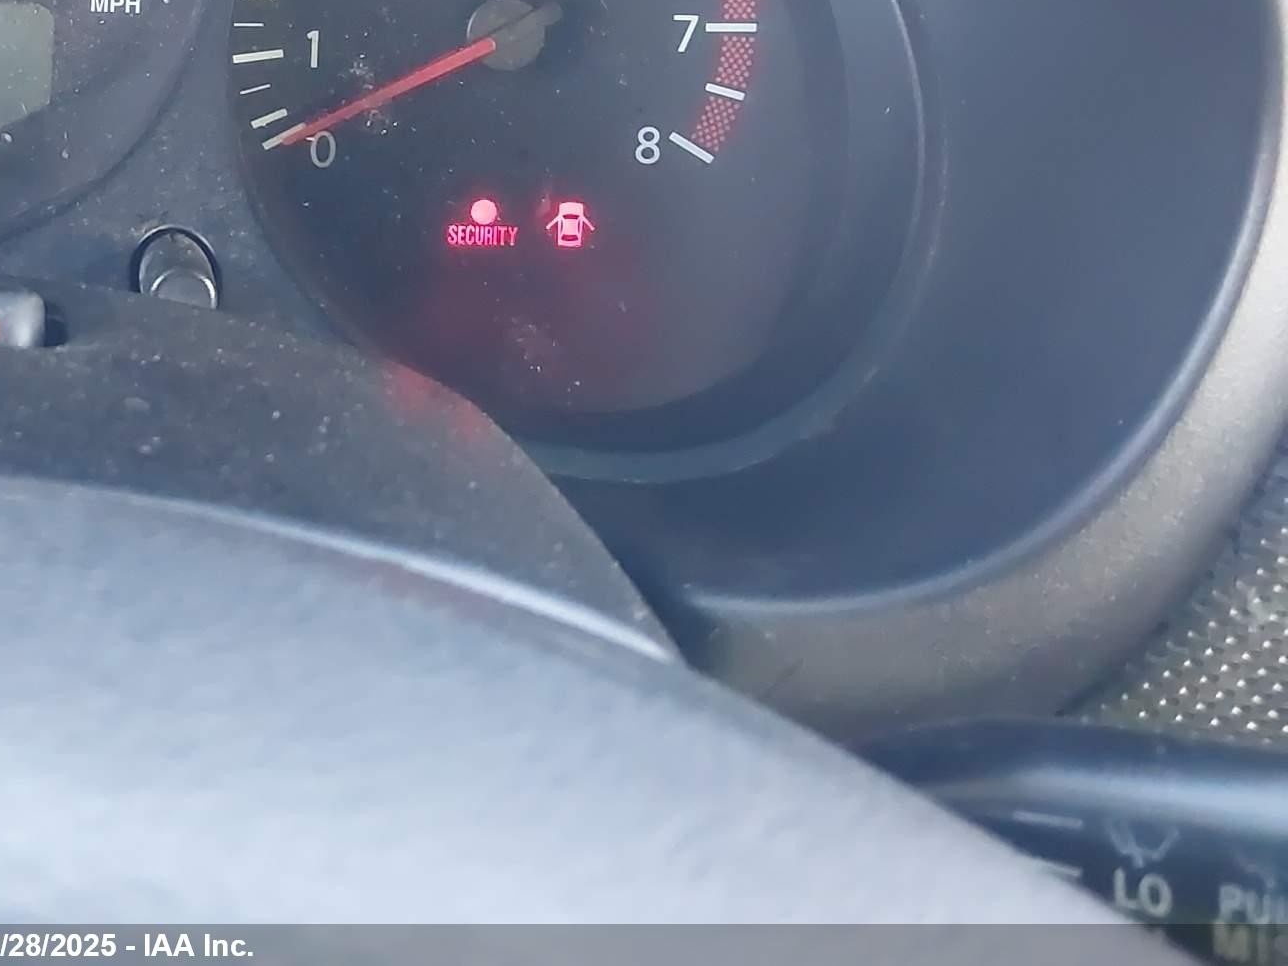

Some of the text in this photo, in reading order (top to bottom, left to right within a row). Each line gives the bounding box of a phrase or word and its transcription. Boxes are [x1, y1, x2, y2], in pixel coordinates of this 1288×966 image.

[306, 30, 318, 67] 1
[673, 15, 699, 52] 7
[310, 130, 336, 168] 0
[635, 127, 660, 164] 8
[448, 225, 518, 246] SECURITY
[1112, 867, 1173, 917] LO
